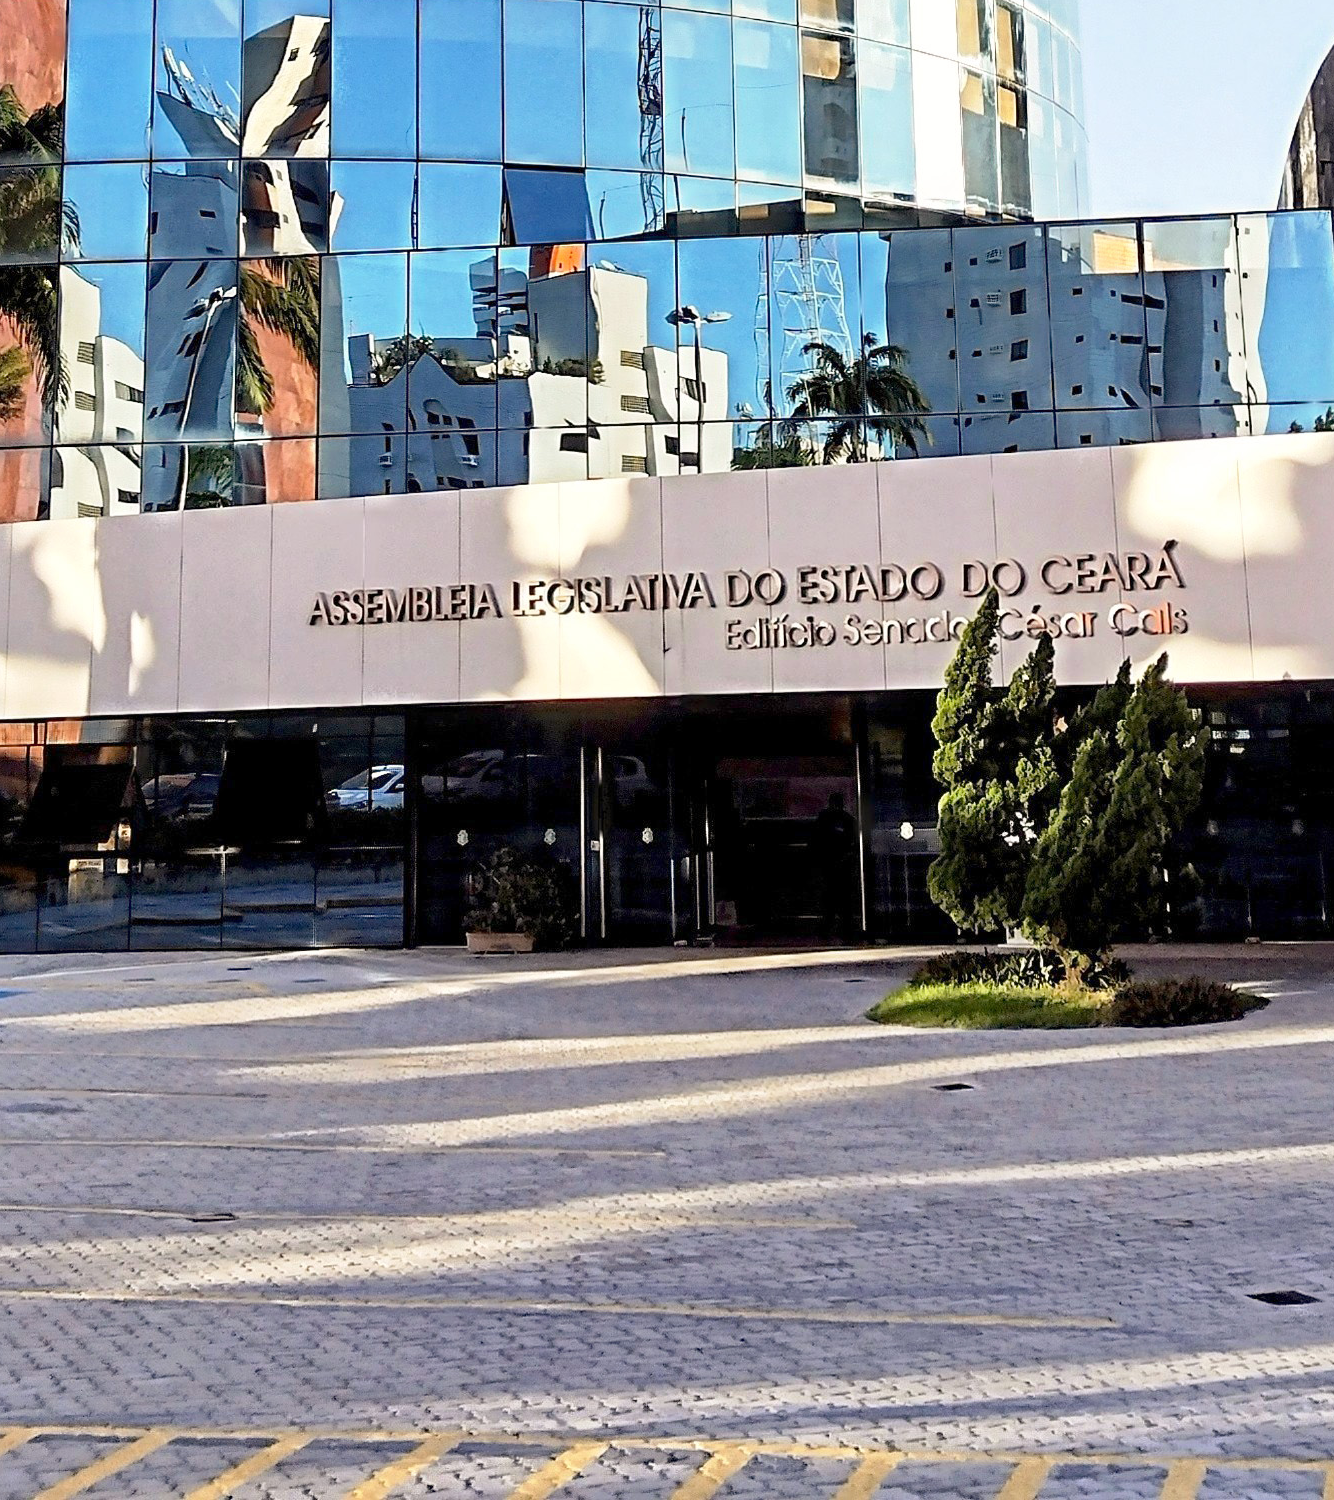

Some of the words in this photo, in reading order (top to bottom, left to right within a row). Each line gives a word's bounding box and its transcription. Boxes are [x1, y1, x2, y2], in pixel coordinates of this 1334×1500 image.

[309, 583, 503, 625] ASSEMBLEIA
[511, 572, 717, 616] LEGISLATIVA
[724, 567, 786, 607] DO
[796, 561, 945, 604] ESTADO
[962, 558, 1026, 597] DO
[1040, 539, 1186, 595] CEARÁ
[725, 614, 836, 650] Edifício
[996, 605, 1098, 640] César
[1107, 601, 1189, 637] Cals
